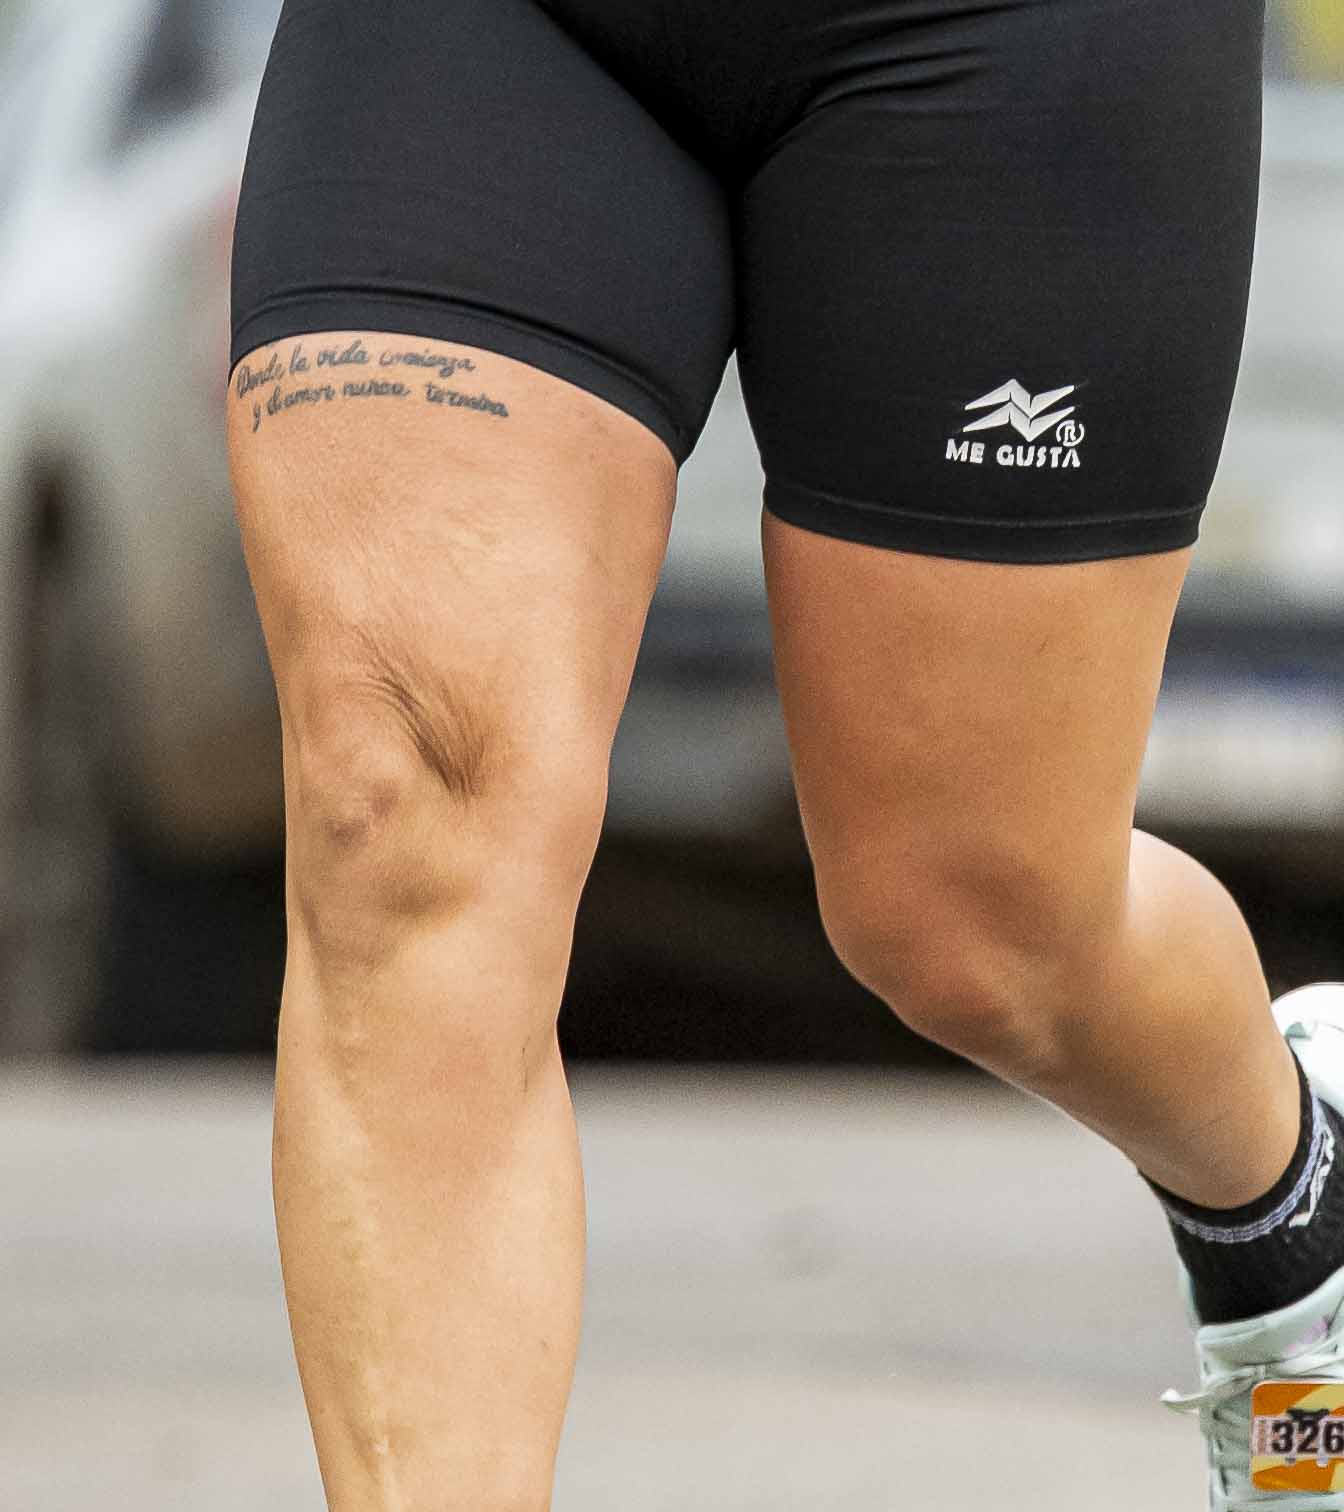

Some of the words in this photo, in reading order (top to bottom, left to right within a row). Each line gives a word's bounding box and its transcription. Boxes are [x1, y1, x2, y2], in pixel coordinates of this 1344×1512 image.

[288, 342, 311, 375] la
[317, 339, 369, 367] vida
[342, 379, 411, 398] nunca
[944, 438, 985, 464] ME
[995, 444, 1081, 468] GUSTA
